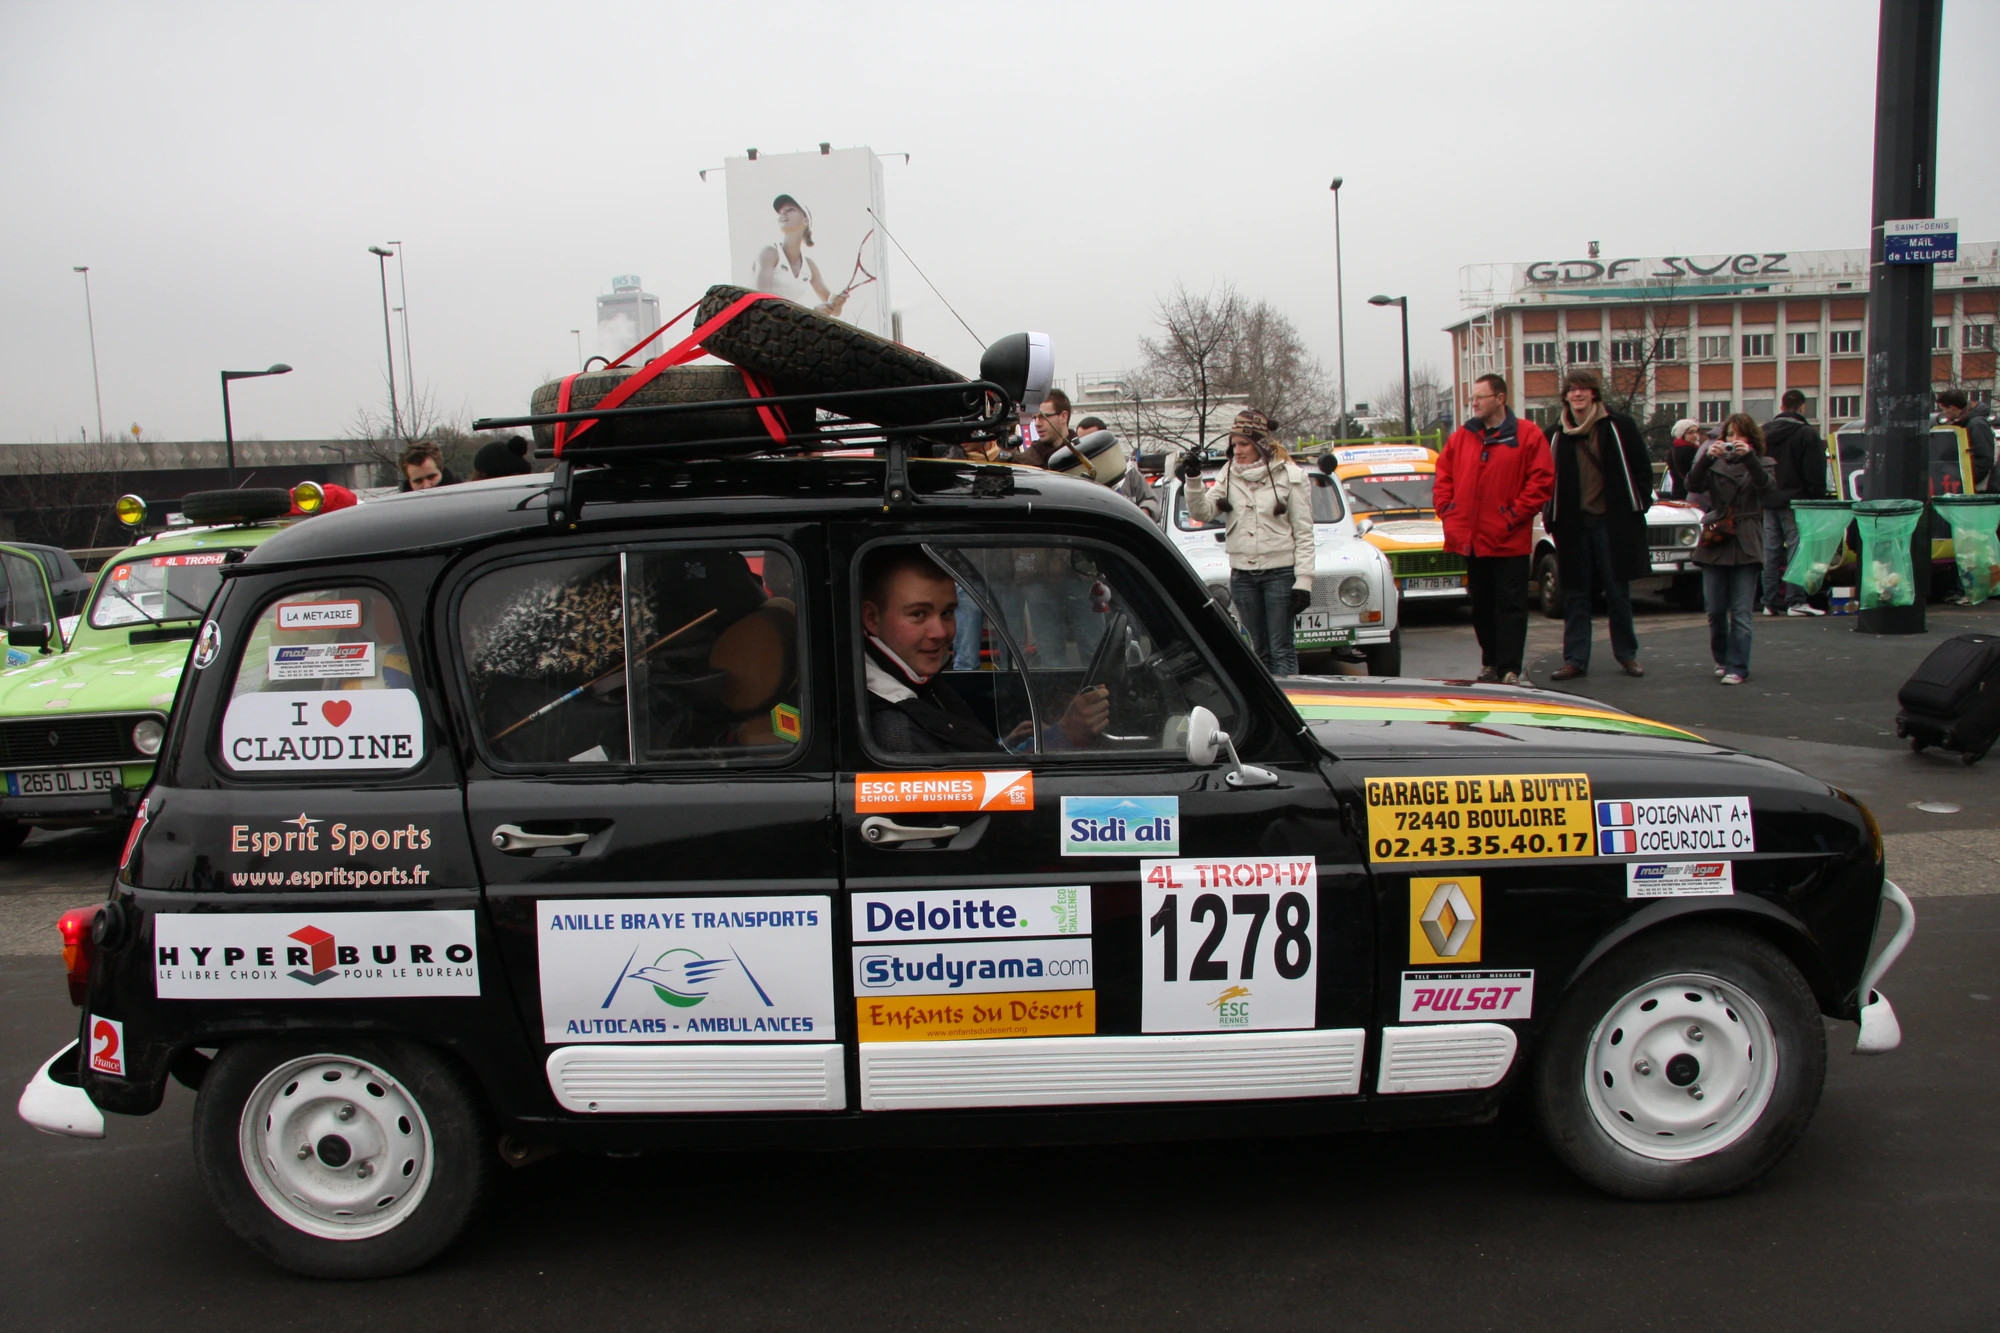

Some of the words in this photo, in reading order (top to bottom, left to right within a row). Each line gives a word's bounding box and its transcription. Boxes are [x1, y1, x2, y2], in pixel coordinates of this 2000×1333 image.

[1894, 222, 1949, 231] SAINT-DENIS
[1909, 238, 1934, 247] MAIL
[1888, 252, 1900, 260] de
[1905, 250, 1954, 260] L'ELLIPSE
[1526, 258, 1640, 283] GDF
[166, 558, 178, 566] 4L
[184, 555, 226, 565] TROPHY
[118, 568, 127, 578] P
[286, 612, 299, 621] LA
[302, 610, 353, 620] METAIRIE
[1307, 615, 1322, 628] 14
[1303, 630, 1350, 638] HABITAT
[292, 702, 308, 726] I
[232, 734, 413, 762] CLAUDINE
[22, 773, 54, 793] 265
[56, 772, 88, 791] DLJ
[92, 770, 114, 790] 59
[861, 782, 896, 794] ESC
[900, 780, 973, 794] RENNES
[1367, 781, 1450, 807] GARAGE
[1456, 780, 1483, 804] DE
[1488, 778, 1516, 803] LA
[1521, 776, 1589, 802] BUTTE
[860, 794, 900, 803] SCHOOL
[922, 794, 974, 802] BUSINESS
[1394, 810, 1460, 831] 72440
[1467, 808, 1567, 829] BOULOIRE
[1637, 804, 1724, 826] POIGNANT
[1730, 804, 1749, 822] A+
[1070, 818, 1127, 842] Sidi
[1134, 816, 1173, 842] ali
[231, 824, 319, 858] Esprit
[330, 822, 432, 856] Sports
[1374, 832, 1589, 858] 02.43.35.40.17
[1640, 830, 1726, 852] COEURJOLI
[232, 864, 431, 888] www.espritsports.fr
[1146, 864, 1184, 889] 4L
[1193, 862, 1312, 888] TROPHY
[1057, 888, 1067, 904] ECO
[550, 914, 614, 930] ANILLE
[621, 912, 686, 930] BRAYE
[692, 910, 818, 928] TRANSPORTS
[866, 899, 1029, 933] Deloitte.
[1068, 888, 1078, 933] CHALLENGE
[1058, 923, 1067, 933] 4L
[1149, 891, 1312, 983] 1278
[160, 969, 172, 980] LE
[180, 969, 221, 980] LIBRE
[230, 968, 279, 980] CHOIX
[344, 968, 384, 979] POUR
[392, 968, 407, 978] LE
[416, 967, 474, 978] BUREAU
[869, 1004, 964, 1030] Enfants
[972, 1004, 1002, 1023] du
[1008, 1000, 1084, 1022] Désert
[1220, 1002, 1249, 1016] ESC
[566, 1018, 666, 1034] AUTOCARS
[686, 1017, 814, 1032] AMBULANCES
[926, 1026, 1028, 1037] www.enfantsdudesert.org
[94, 1020, 120, 1073] 2
[94, 1056, 120, 1070] France
